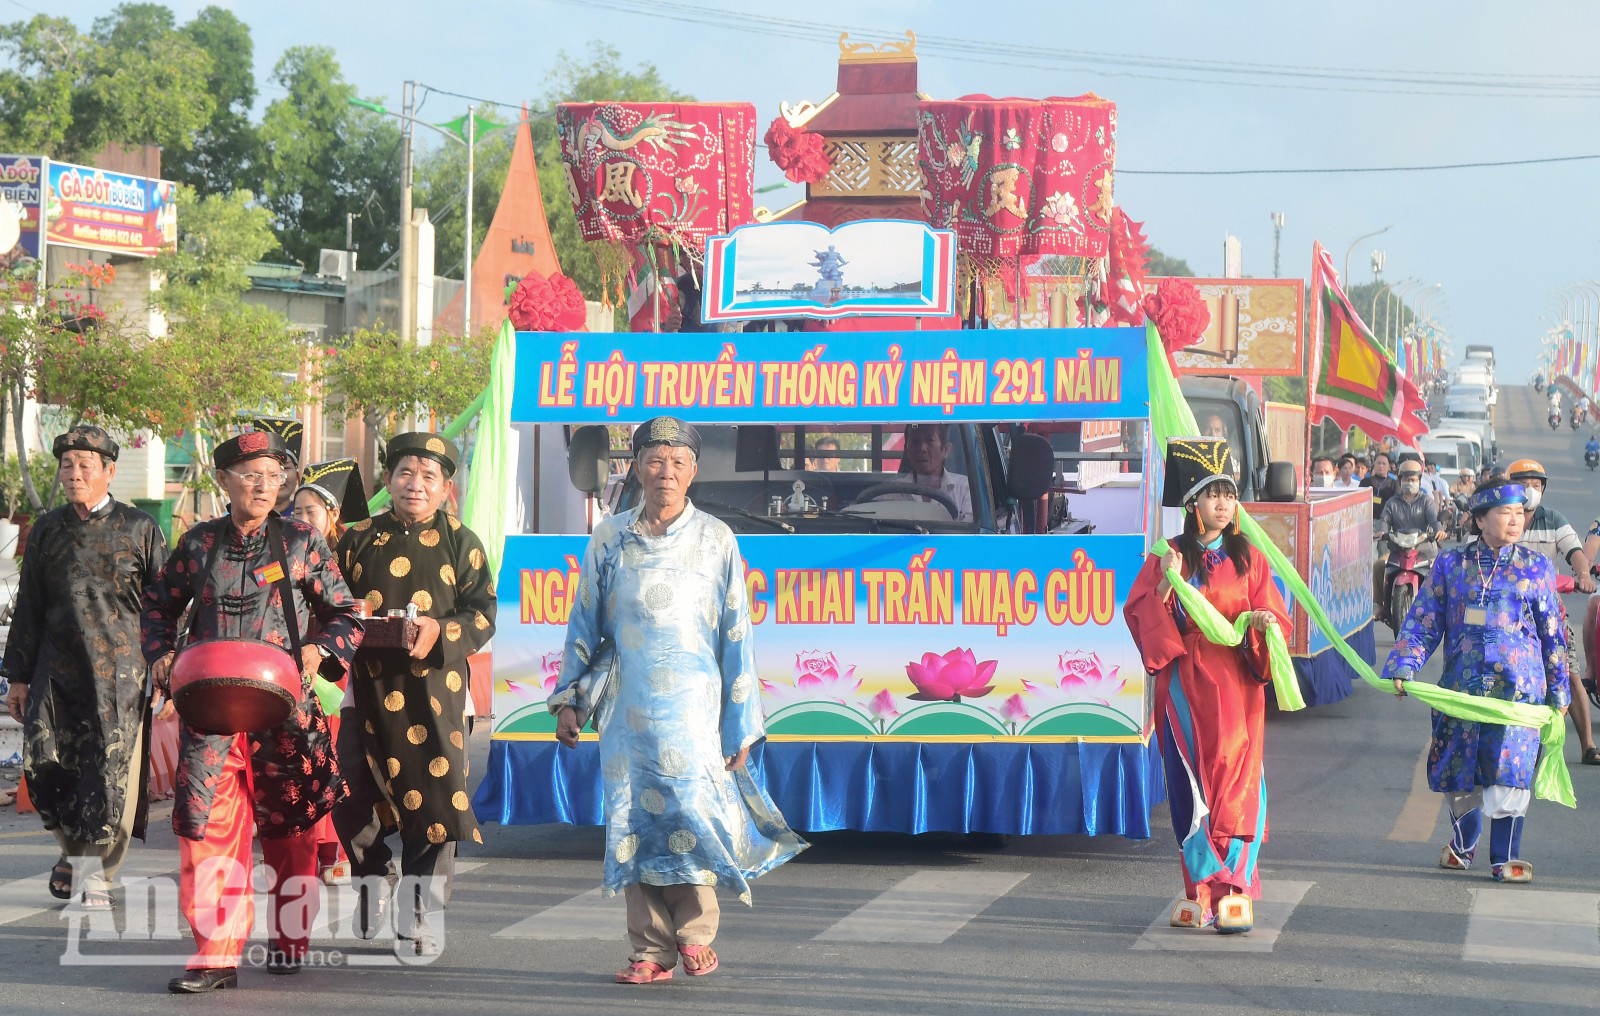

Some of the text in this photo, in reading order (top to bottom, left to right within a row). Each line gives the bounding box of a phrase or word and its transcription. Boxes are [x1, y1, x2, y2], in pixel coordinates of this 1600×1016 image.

[60, 169, 82, 199] GÀ
[539, 341, 1122, 416] LỄ HỘI TRUYỀN THỐNG KỶ NIỆM 291 NĂM
[775, 568, 855, 624] KHAI
[861, 548, 954, 625] TRẤN
[962, 568, 1037, 636] MẠC
[1045, 548, 1116, 626] CỬU
